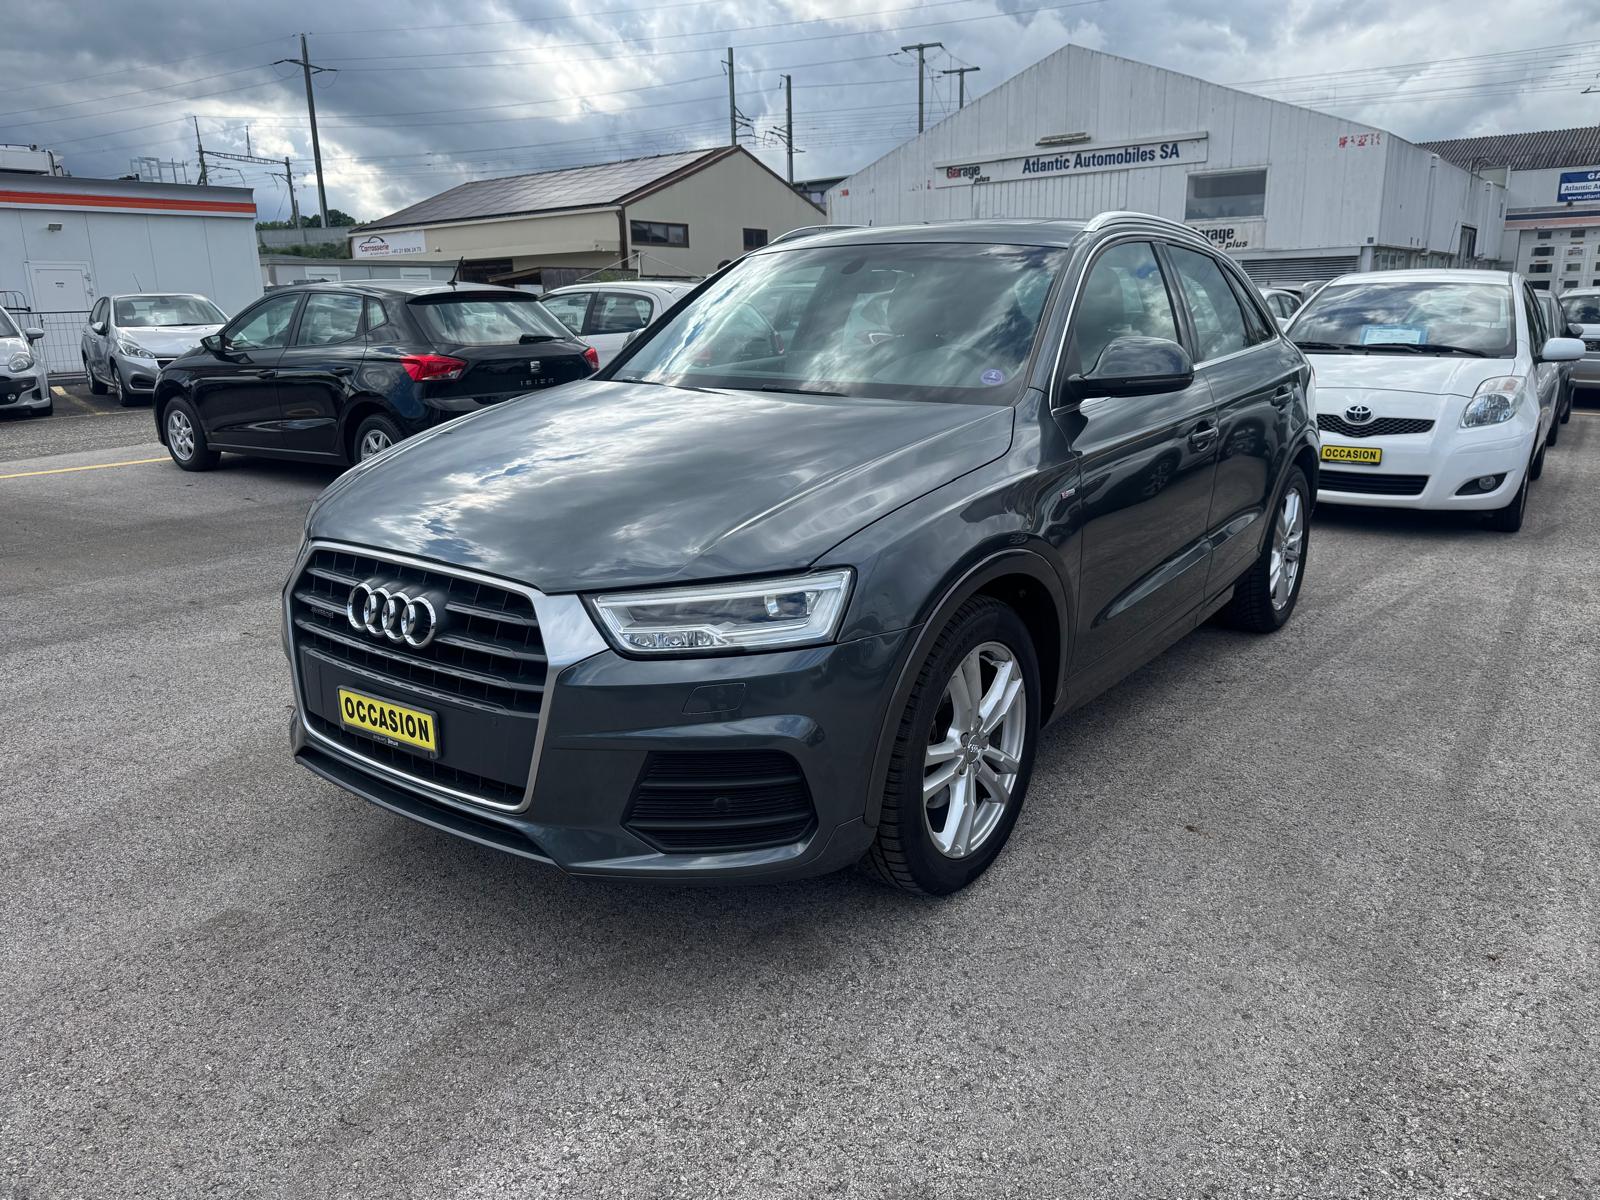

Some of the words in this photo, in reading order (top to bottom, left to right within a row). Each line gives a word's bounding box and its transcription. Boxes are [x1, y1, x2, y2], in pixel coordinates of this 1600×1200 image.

[1022, 155, 1070, 174] Atlantic
[1073, 147, 1156, 169] Automobiles
[1159, 142, 1180, 160] SA
[946, 165, 981, 180] Garage
[973, 175, 991, 185] plus
[1192, 227, 1235, 244] rage
[1225, 239, 1249, 250] plus
[1325, 448, 1377, 460] OCCASION
[344, 696, 430, 743] OCCASION
